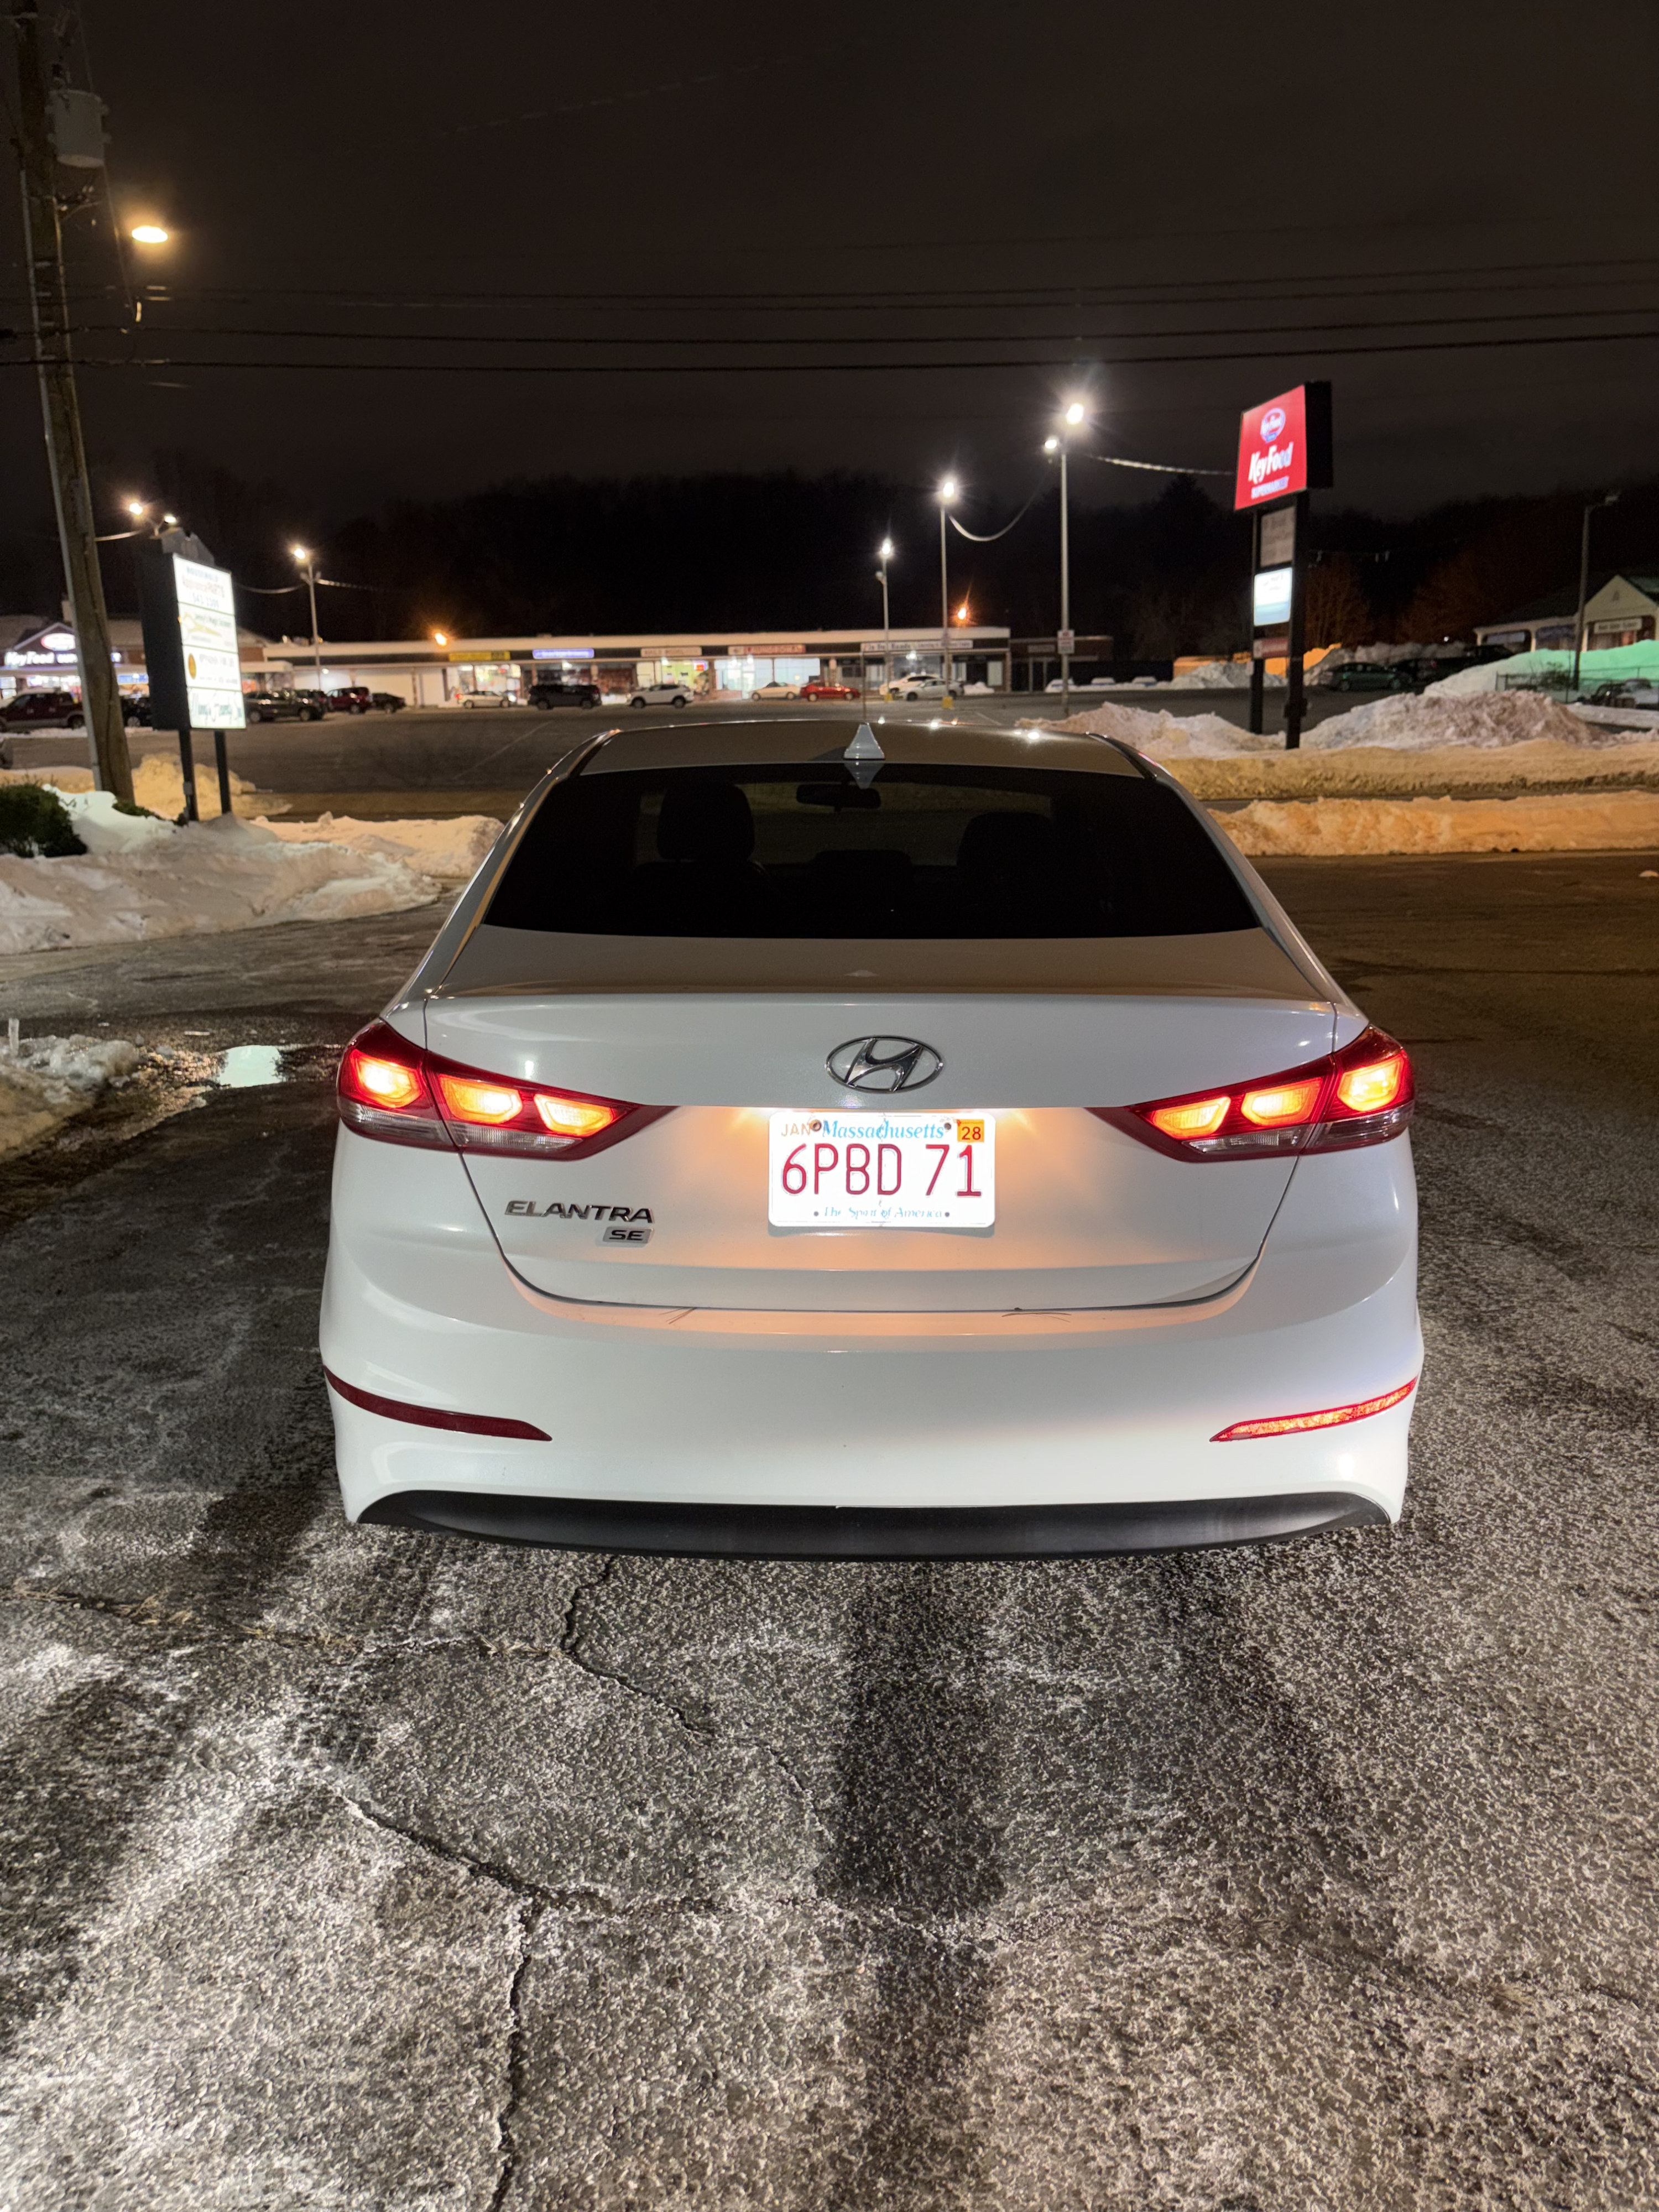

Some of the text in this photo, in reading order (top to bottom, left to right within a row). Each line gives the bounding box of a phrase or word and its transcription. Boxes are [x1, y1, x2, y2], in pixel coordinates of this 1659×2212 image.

[781, 1123, 812, 1138] JAN
[823, 1118, 945, 1139] Massachusetts
[961, 1126, 981, 1141] 28
[781, 1143, 982, 1197] 6PBD 71
[504, 1200, 655, 1224] ELANTRA
[824, 1207, 942, 1220] The Spirit of America
[608, 1229, 645, 1241] SE
